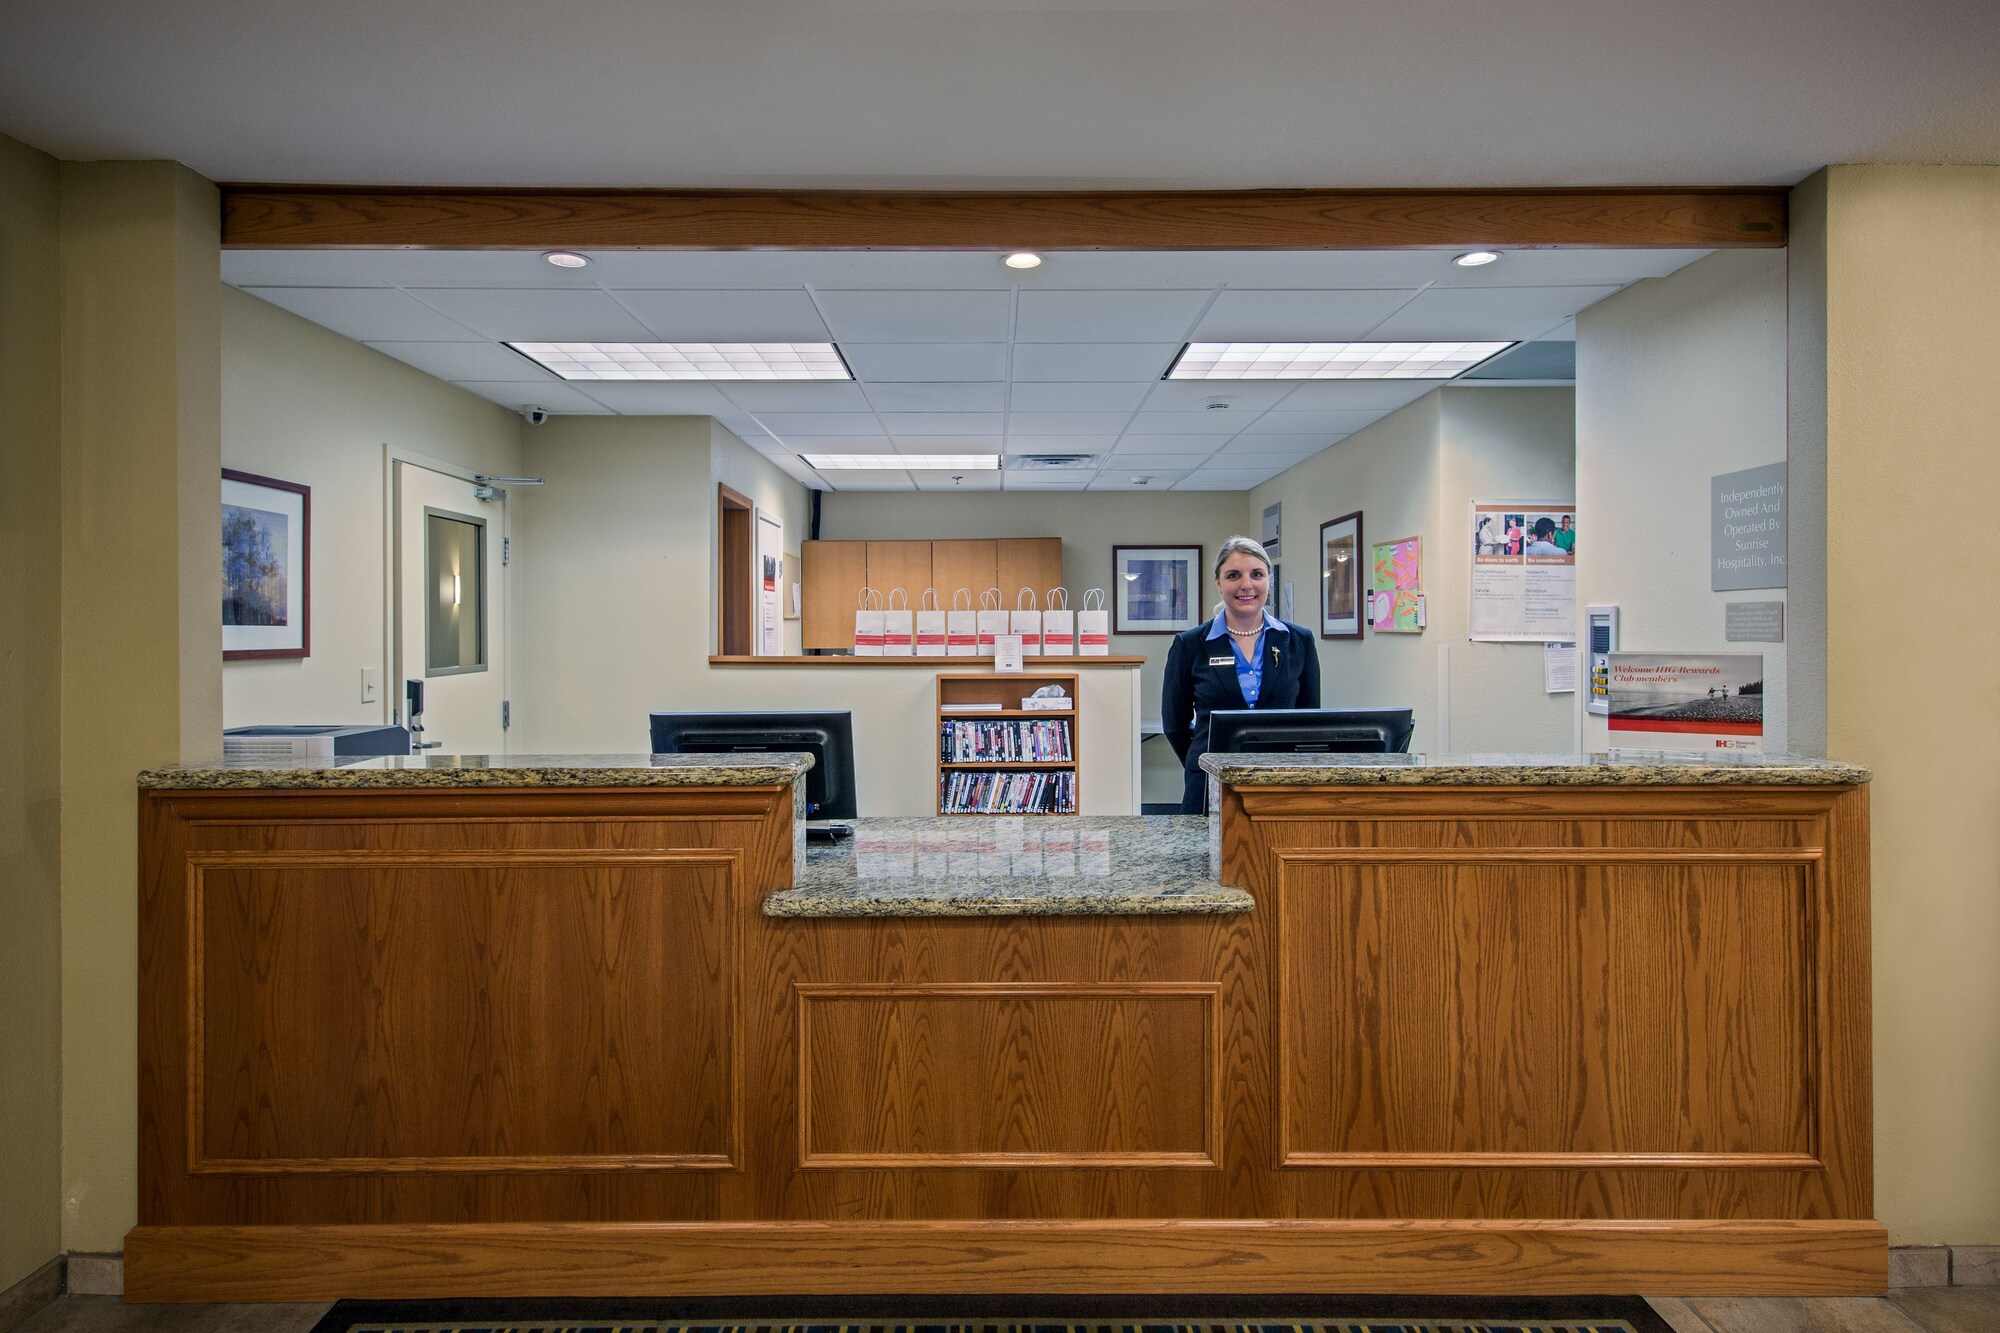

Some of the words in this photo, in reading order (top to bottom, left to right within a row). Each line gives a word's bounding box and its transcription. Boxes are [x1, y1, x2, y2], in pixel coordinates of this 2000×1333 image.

[1720, 481, 1785, 504] Independently
[1725, 502, 1759, 520] Owned
[1761, 499, 1780, 514] And
[1724, 519, 1766, 539] Operated
[1769, 518, 1781, 533] By
[1735, 537, 1769, 552] Sunrise
[1717, 554, 1768, 572] Hospitality,
[1614, 665, 1654, 674] Welcome
[1656, 666, 1676, 674] IHG
[1679, 666, 1721, 675] Rewards
[1636, 675, 1678, 683] members
[1716, 740, 1734, 749] IHG
